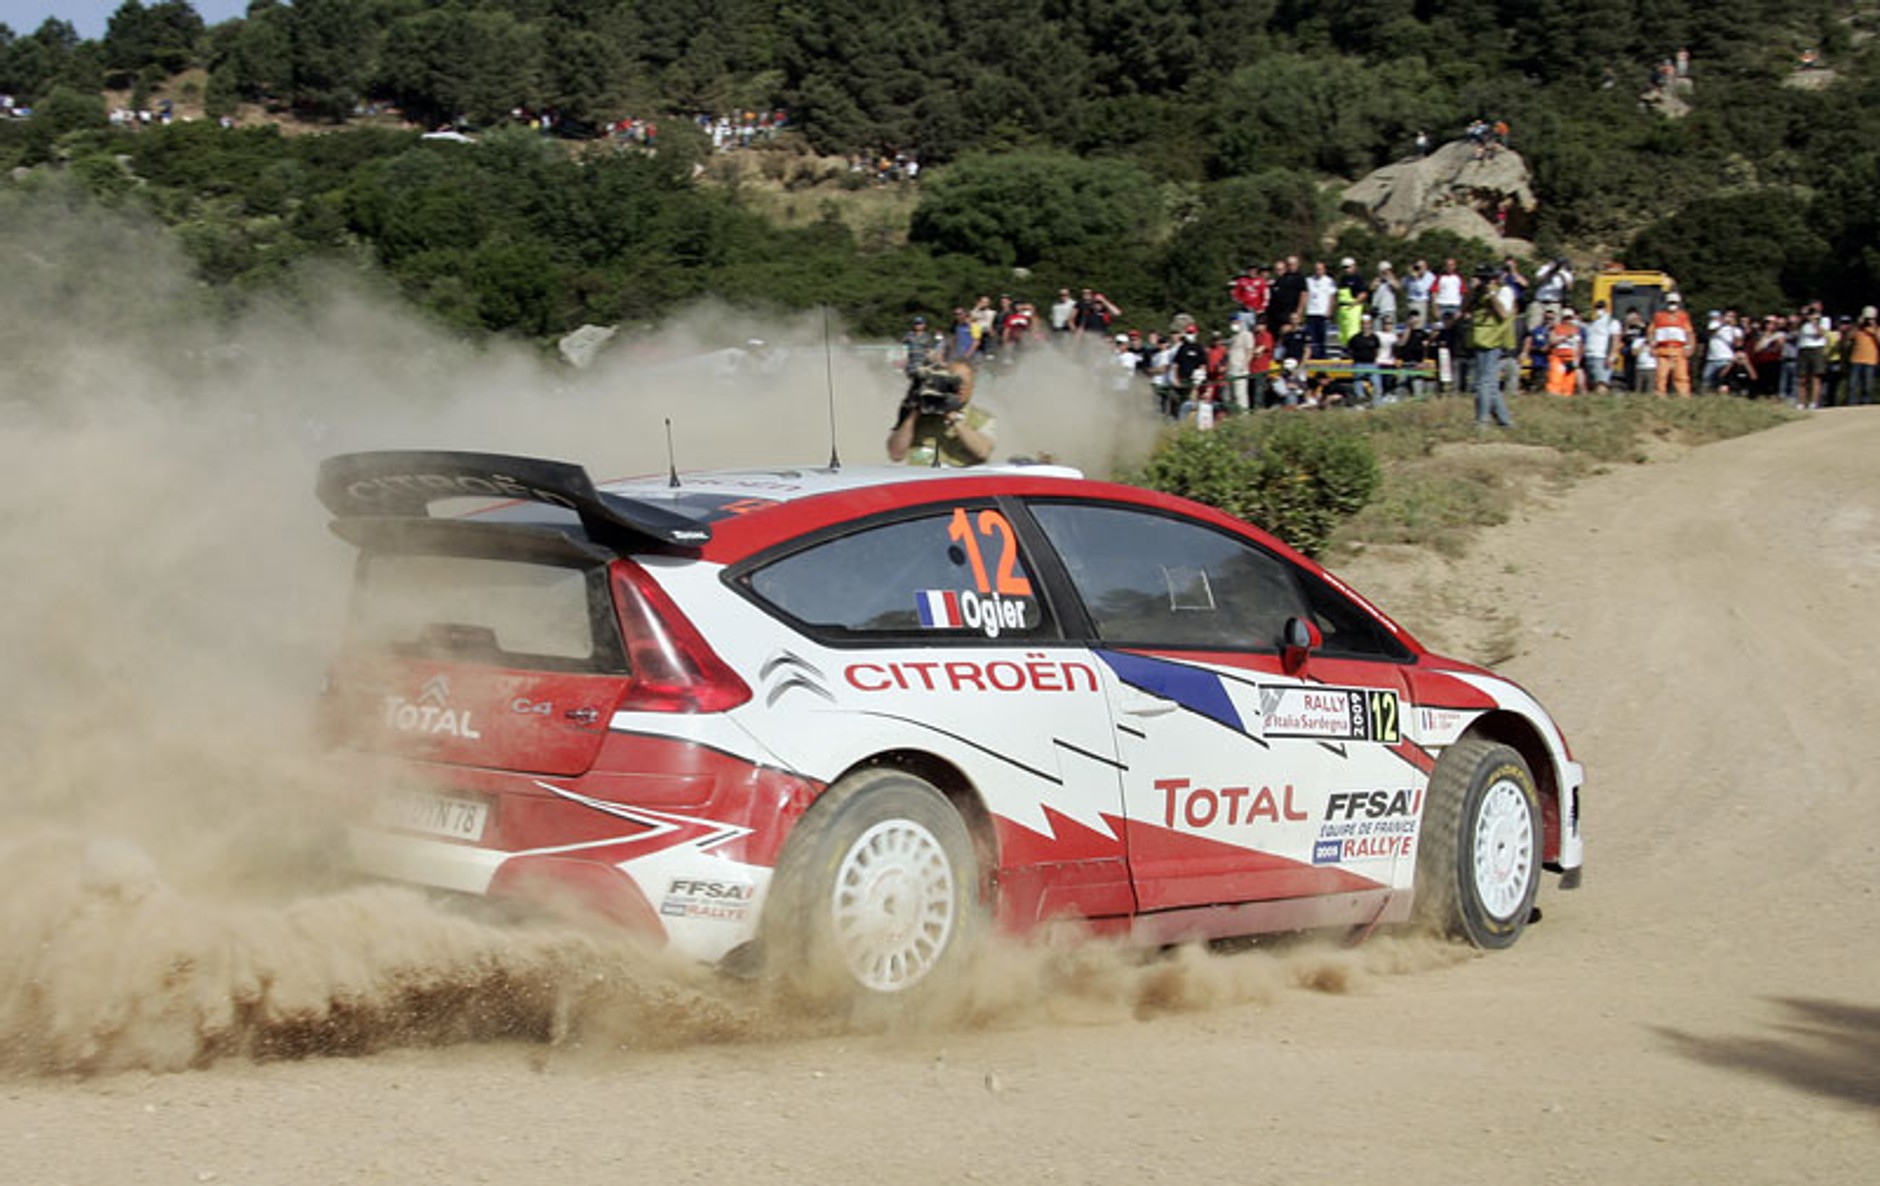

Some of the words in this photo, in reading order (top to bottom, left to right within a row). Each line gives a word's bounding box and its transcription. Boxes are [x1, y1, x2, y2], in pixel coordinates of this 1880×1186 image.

[946, 507, 1033, 596] 12
[960, 589, 1027, 638] Ogier
[844, 652, 1099, 692] CITROËN
[511, 698, 552, 716] C4
[1304, 694, 1347, 714] RALLY
[1350, 692, 1366, 738] 2009
[1371, 692, 1398, 742] 12
[1300, 713, 1349, 733] Sardegna
[1325, 788, 1409, 821] FFSA
[668, 880, 743, 900] FFSA
